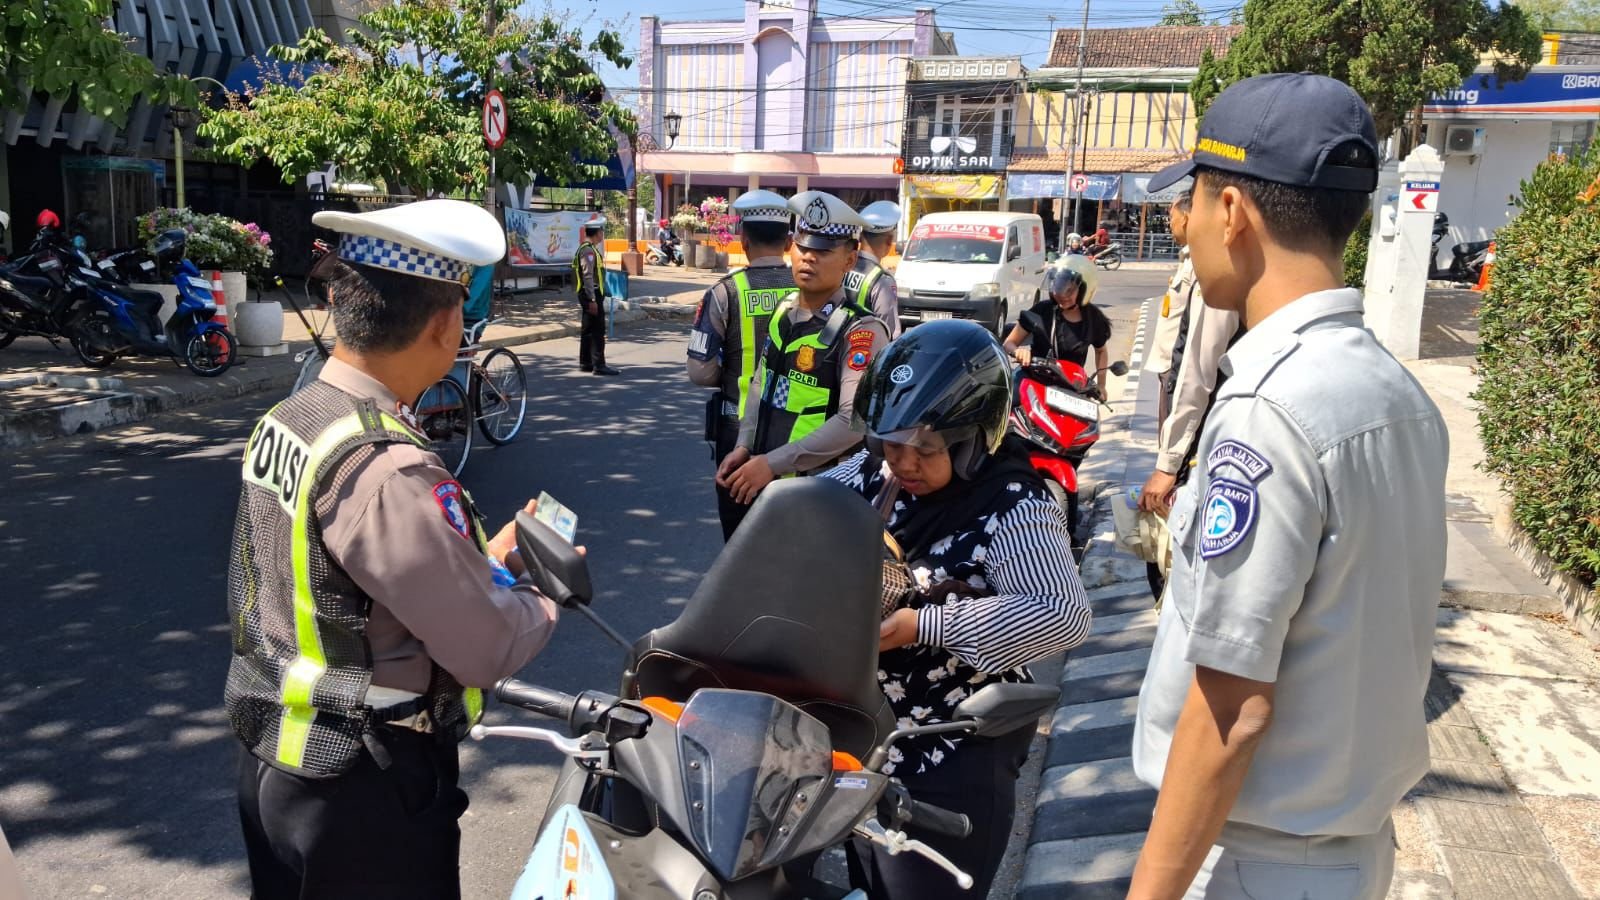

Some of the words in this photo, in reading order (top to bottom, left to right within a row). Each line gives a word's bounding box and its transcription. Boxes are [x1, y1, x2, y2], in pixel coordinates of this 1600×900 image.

[1210, 140, 1246, 163] RAHARJA
[912, 155, 954, 169] OPTIK
[959, 156, 993, 168] SARI
[789, 371, 817, 386] POLRI
[249, 419, 309, 511] POLISI
[1234, 450, 1261, 473] JATIM
[1224, 488, 1249, 504] BAKTI
